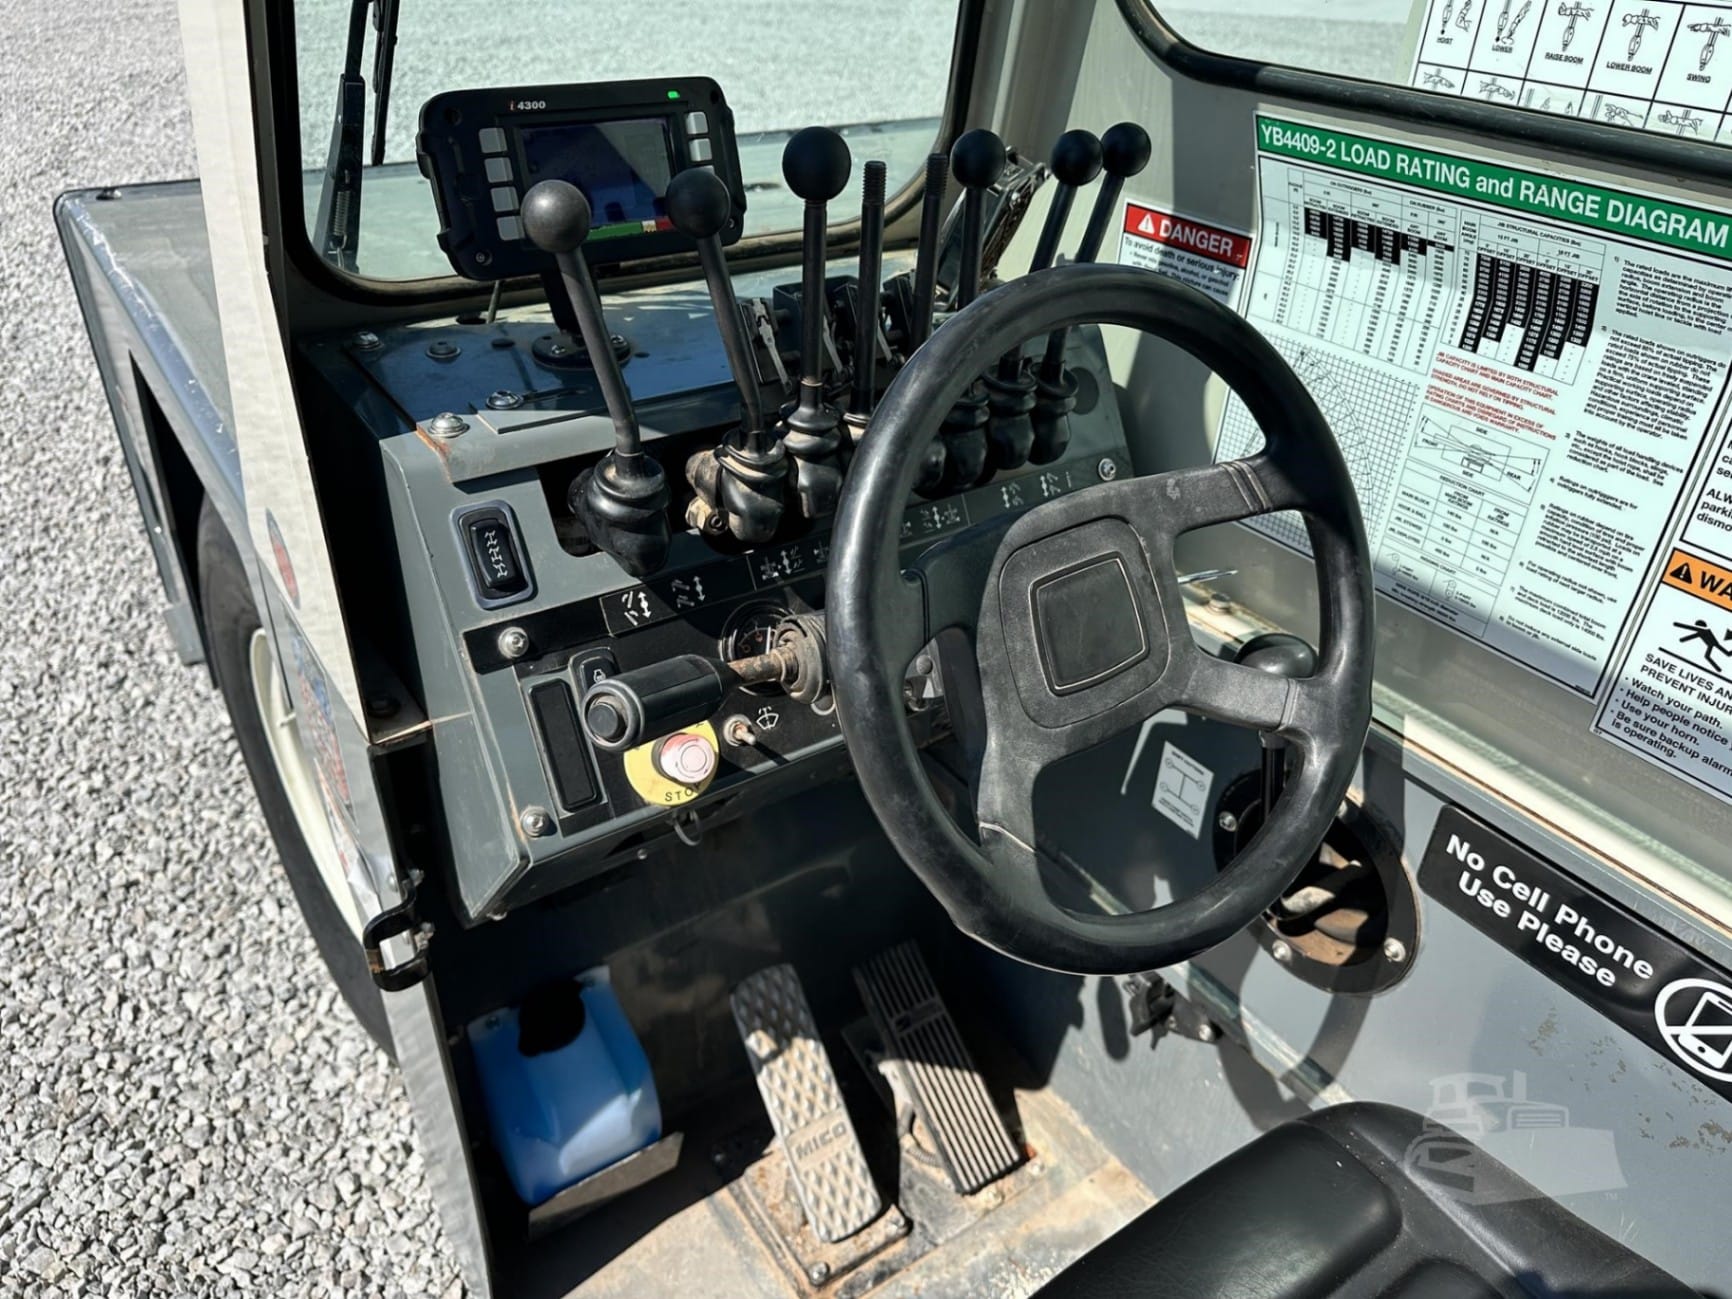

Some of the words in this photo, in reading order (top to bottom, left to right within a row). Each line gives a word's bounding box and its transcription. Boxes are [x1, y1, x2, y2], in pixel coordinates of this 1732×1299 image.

[1436, 37, 1453, 45] HOIST
[1491, 45, 1513, 53] LOWER
[1545, 52, 1564, 61] RAISE
[1564, 55, 1584, 65] BOOM
[1606, 61, 1630, 71] LOWER
[1631, 64, 1653, 75] BOOM
[1686, 73, 1711, 84] SWING
[517, 100, 546, 111] 4300
[1260, 124, 1337, 159] YB4409-2
[1341, 141, 1391, 171] LOAD
[1396, 154, 1470, 189] RATING
[1476, 176, 1513, 199] and
[1520, 180, 1601, 219] RANGE
[1606, 199, 1729, 249] DIAGRAM
[1125, 236, 1132, 246] To
[1134, 241, 1153, 252] avoid
[1154, 245, 1175, 260] death
[1187, 258, 1214, 272] serious
[1159, 219, 1233, 256] DANGER
[1641, 665, 1696, 695] PREVENT
[1646, 654, 1676, 673] SAVE
[1679, 669, 1713, 691] LIVES
[1626, 689, 1650, 707] Help
[1651, 704, 1690, 726] people
[1692, 724, 1728, 745] notice
[1632, 678, 1664, 700] Watch
[1665, 697, 1693, 713] your
[1693, 711, 1722, 730] path.
[1611, 718, 1621, 729] is
[1624, 727, 1676, 758] operating.
[1616, 711, 1631, 724] Be
[1633, 721, 1657, 737] sure
[1657, 732, 1699, 759] backup
[1621, 700, 1642, 716] Use
[1643, 712, 1669, 729] your
[1671, 725, 1699, 746] horn.
[1446, 834, 1485, 872] No
[1492, 866, 1550, 912] Cell
[1554, 904, 1654, 979] Phone
[1459, 871, 1511, 918] Use
[1517, 910, 1616, 987] Please
[795, 1121, 847, 1160] MICO
